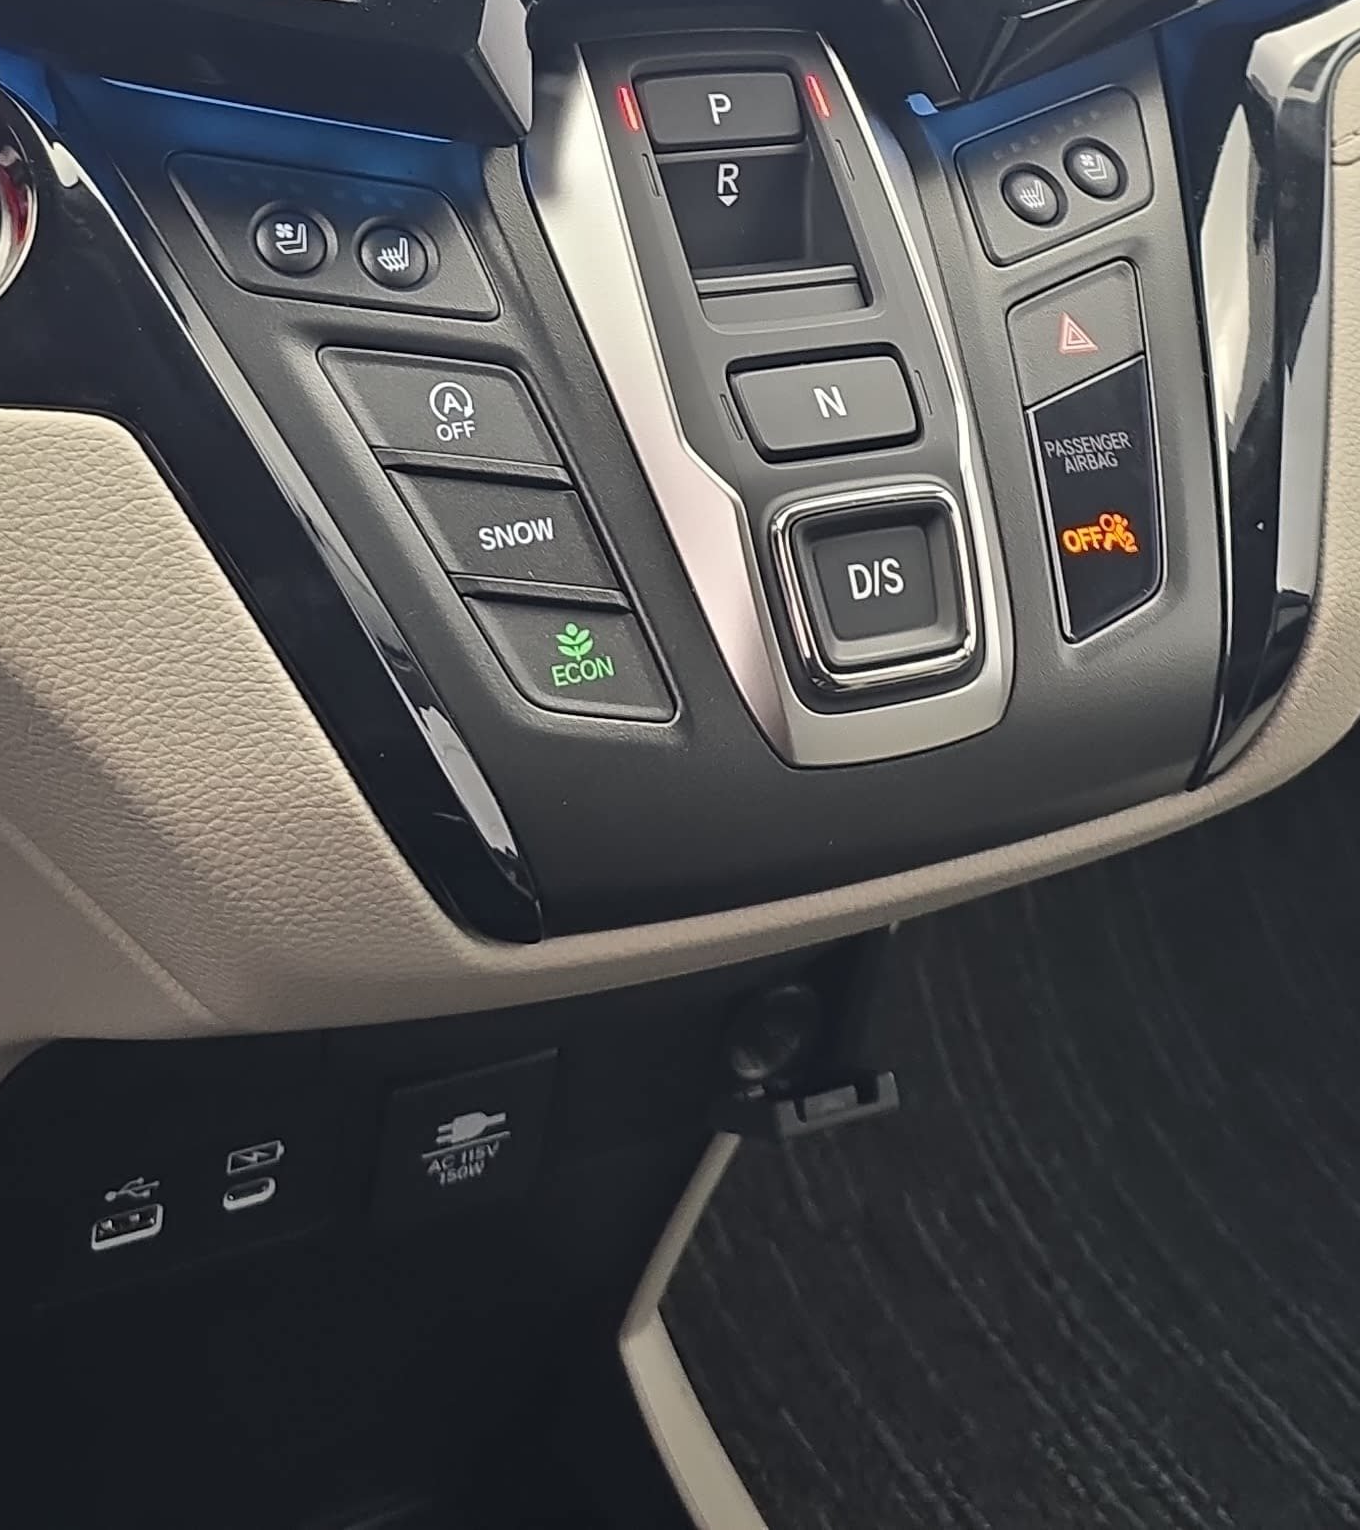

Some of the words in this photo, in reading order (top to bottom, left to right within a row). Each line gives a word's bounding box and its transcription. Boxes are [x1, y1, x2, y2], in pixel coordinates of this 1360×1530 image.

[708, 93, 732, 125] P
[716, 163, 740, 194] R
[813, 386, 848, 419] N
[435, 420, 476, 442] OFF
[1042, 430, 1133, 459] PASSENGER
[1063, 449, 1119, 474] AIRBAG
[477, 516, 555, 551] SNOW
[1062, 525, 1104, 554] OFF
[846, 557, 906, 601] D/S
[550, 654, 616, 688] ECON
[426, 1152, 456, 1174] AC
[461, 1140, 500, 1164] 115V
[439, 1159, 486, 1186] 150W
